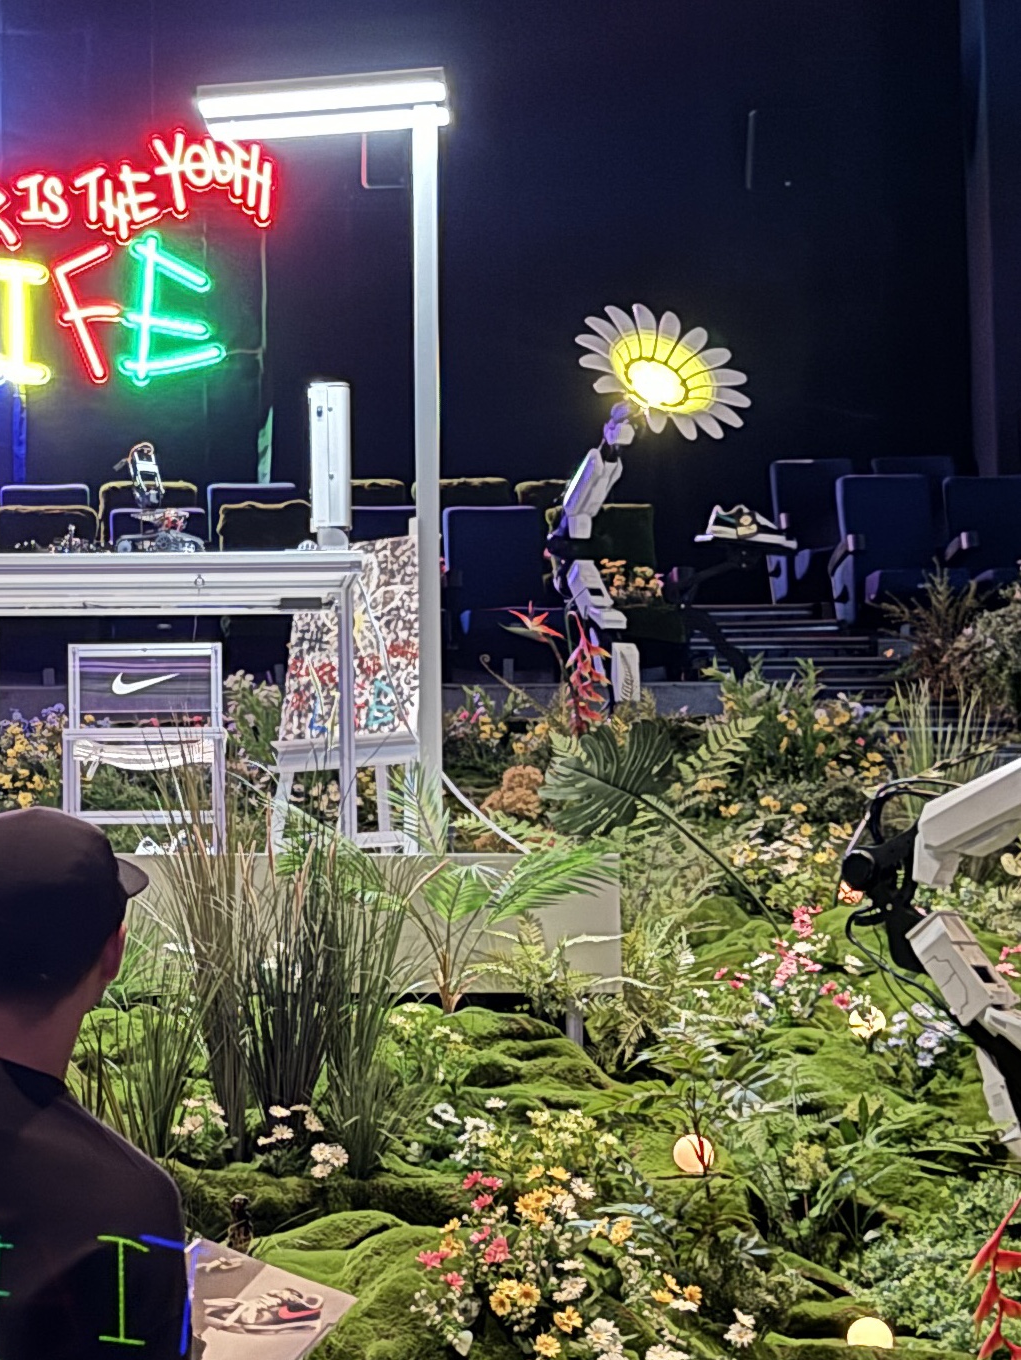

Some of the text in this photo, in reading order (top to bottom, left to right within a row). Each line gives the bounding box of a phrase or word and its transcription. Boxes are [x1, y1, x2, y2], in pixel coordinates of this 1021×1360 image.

[14, 173, 71, 227] IS
[75, 160, 158, 245] THE
[151, 128, 273, 228] YOUTH
